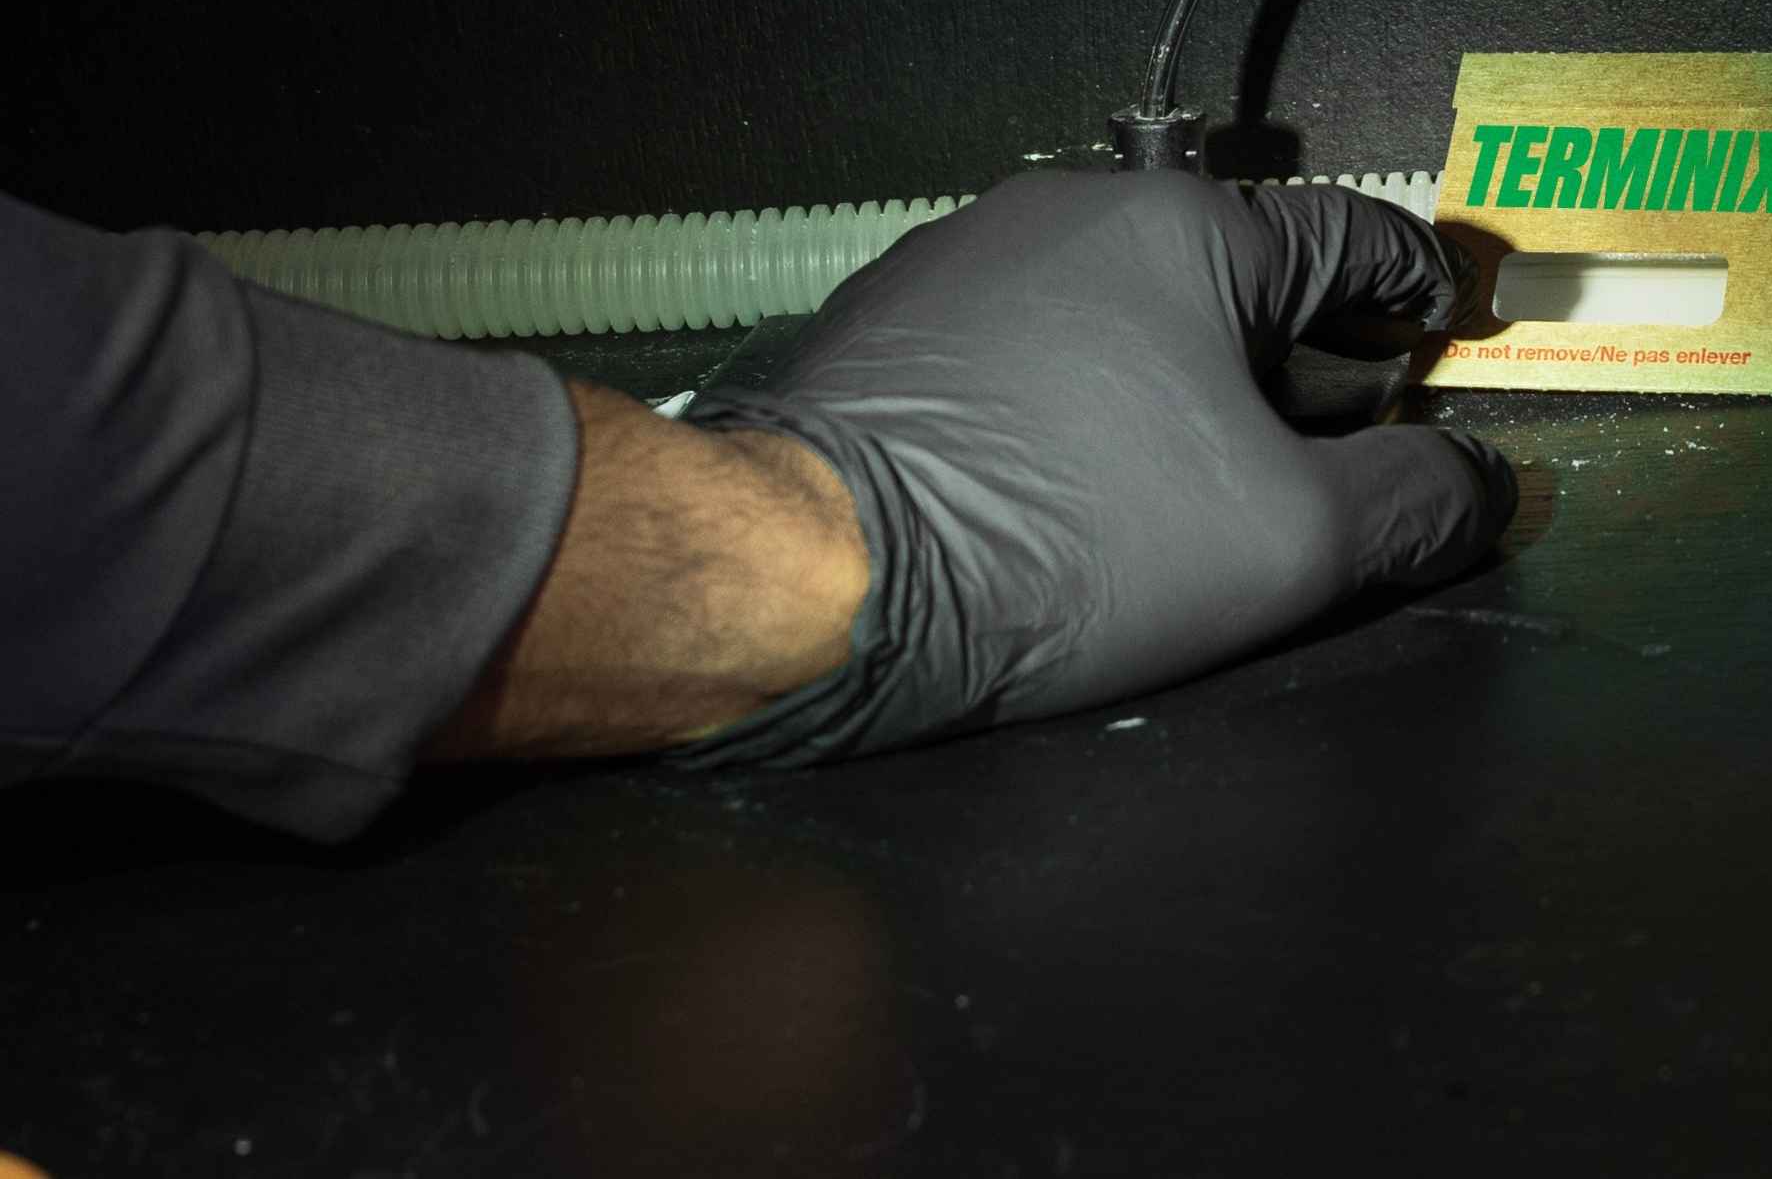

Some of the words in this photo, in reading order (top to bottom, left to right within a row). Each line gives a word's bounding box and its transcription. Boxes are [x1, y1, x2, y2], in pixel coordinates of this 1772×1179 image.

[1446, 343, 1471, 360] Do
[1477, 344, 1512, 360] not
[1516, 343, 1627, 363] remove/Ne
[1633, 348, 1670, 366] pas
[1675, 347, 1753, 366] enlever
